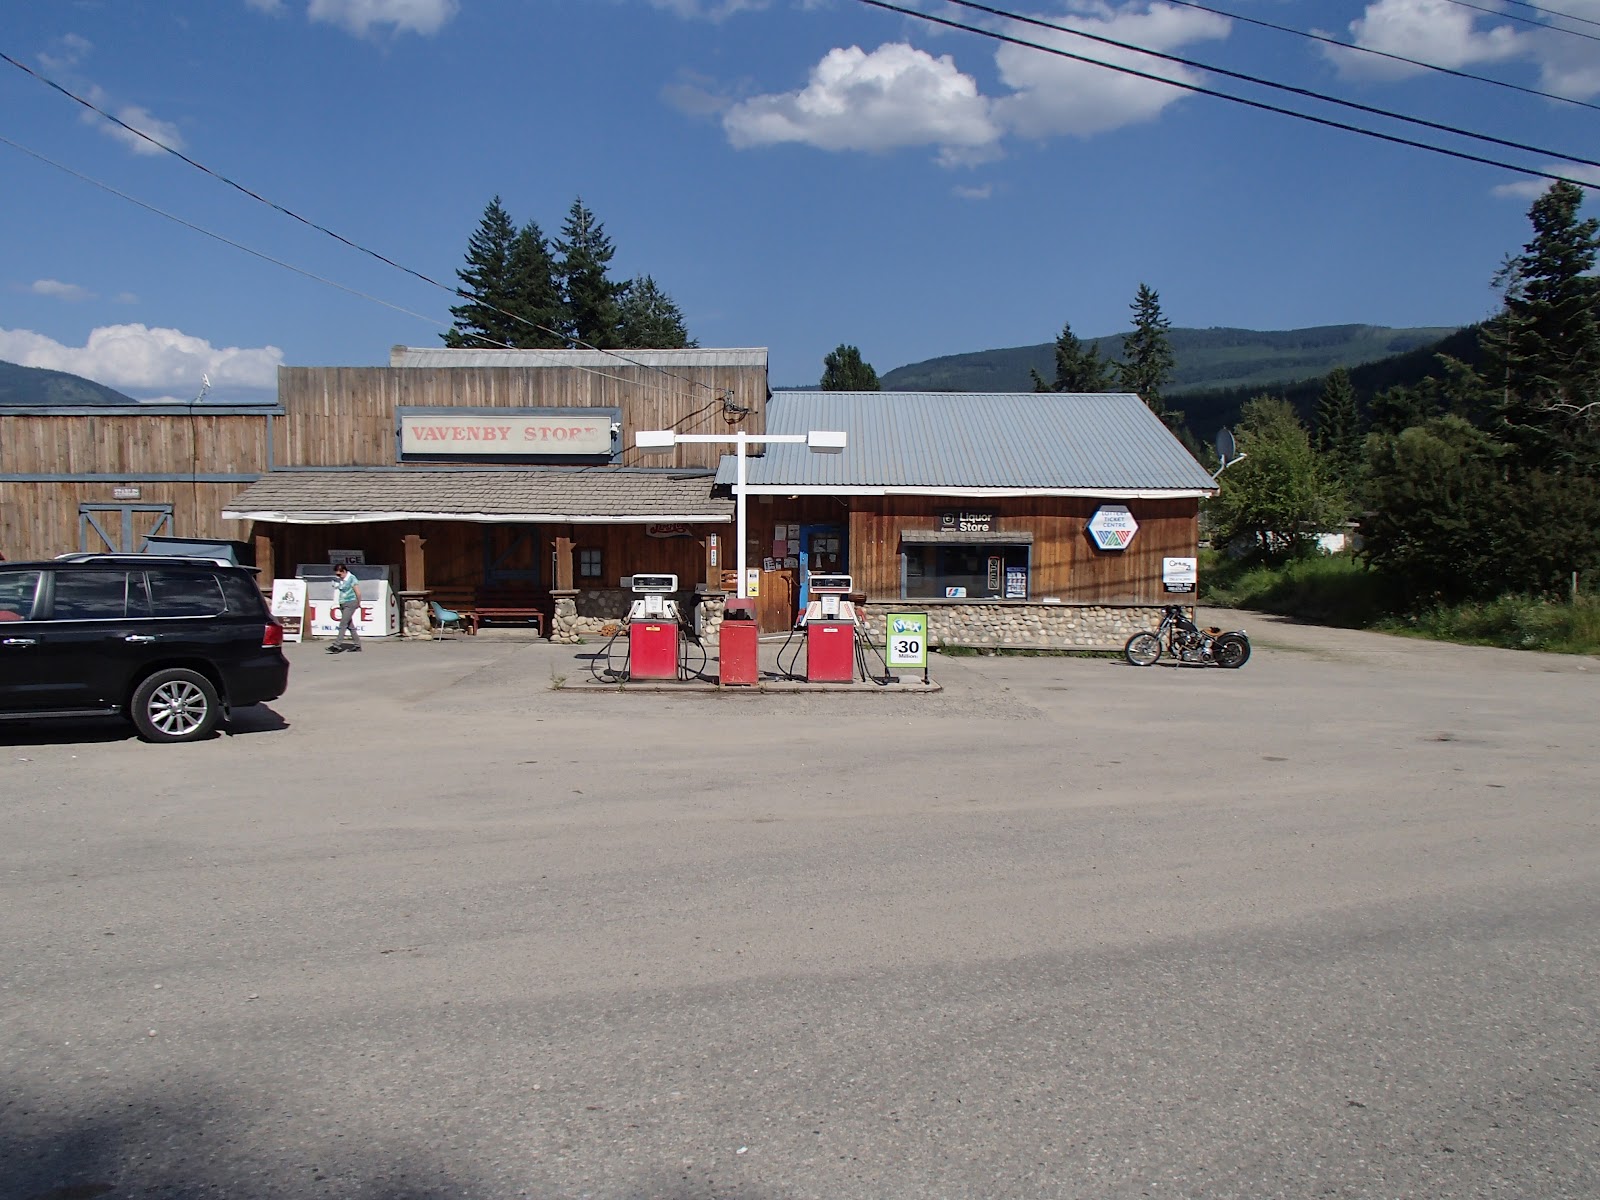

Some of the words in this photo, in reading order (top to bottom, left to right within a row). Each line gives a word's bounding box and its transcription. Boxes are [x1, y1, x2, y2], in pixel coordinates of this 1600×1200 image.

[412, 426, 512, 441] VAVENBY
[959, 512, 992, 523] Liquor
[959, 522, 990, 532] Store
[345, 556, 362, 564] ICE
[309, 606, 374, 622] ICE
[893, 619, 922, 633] MAX
